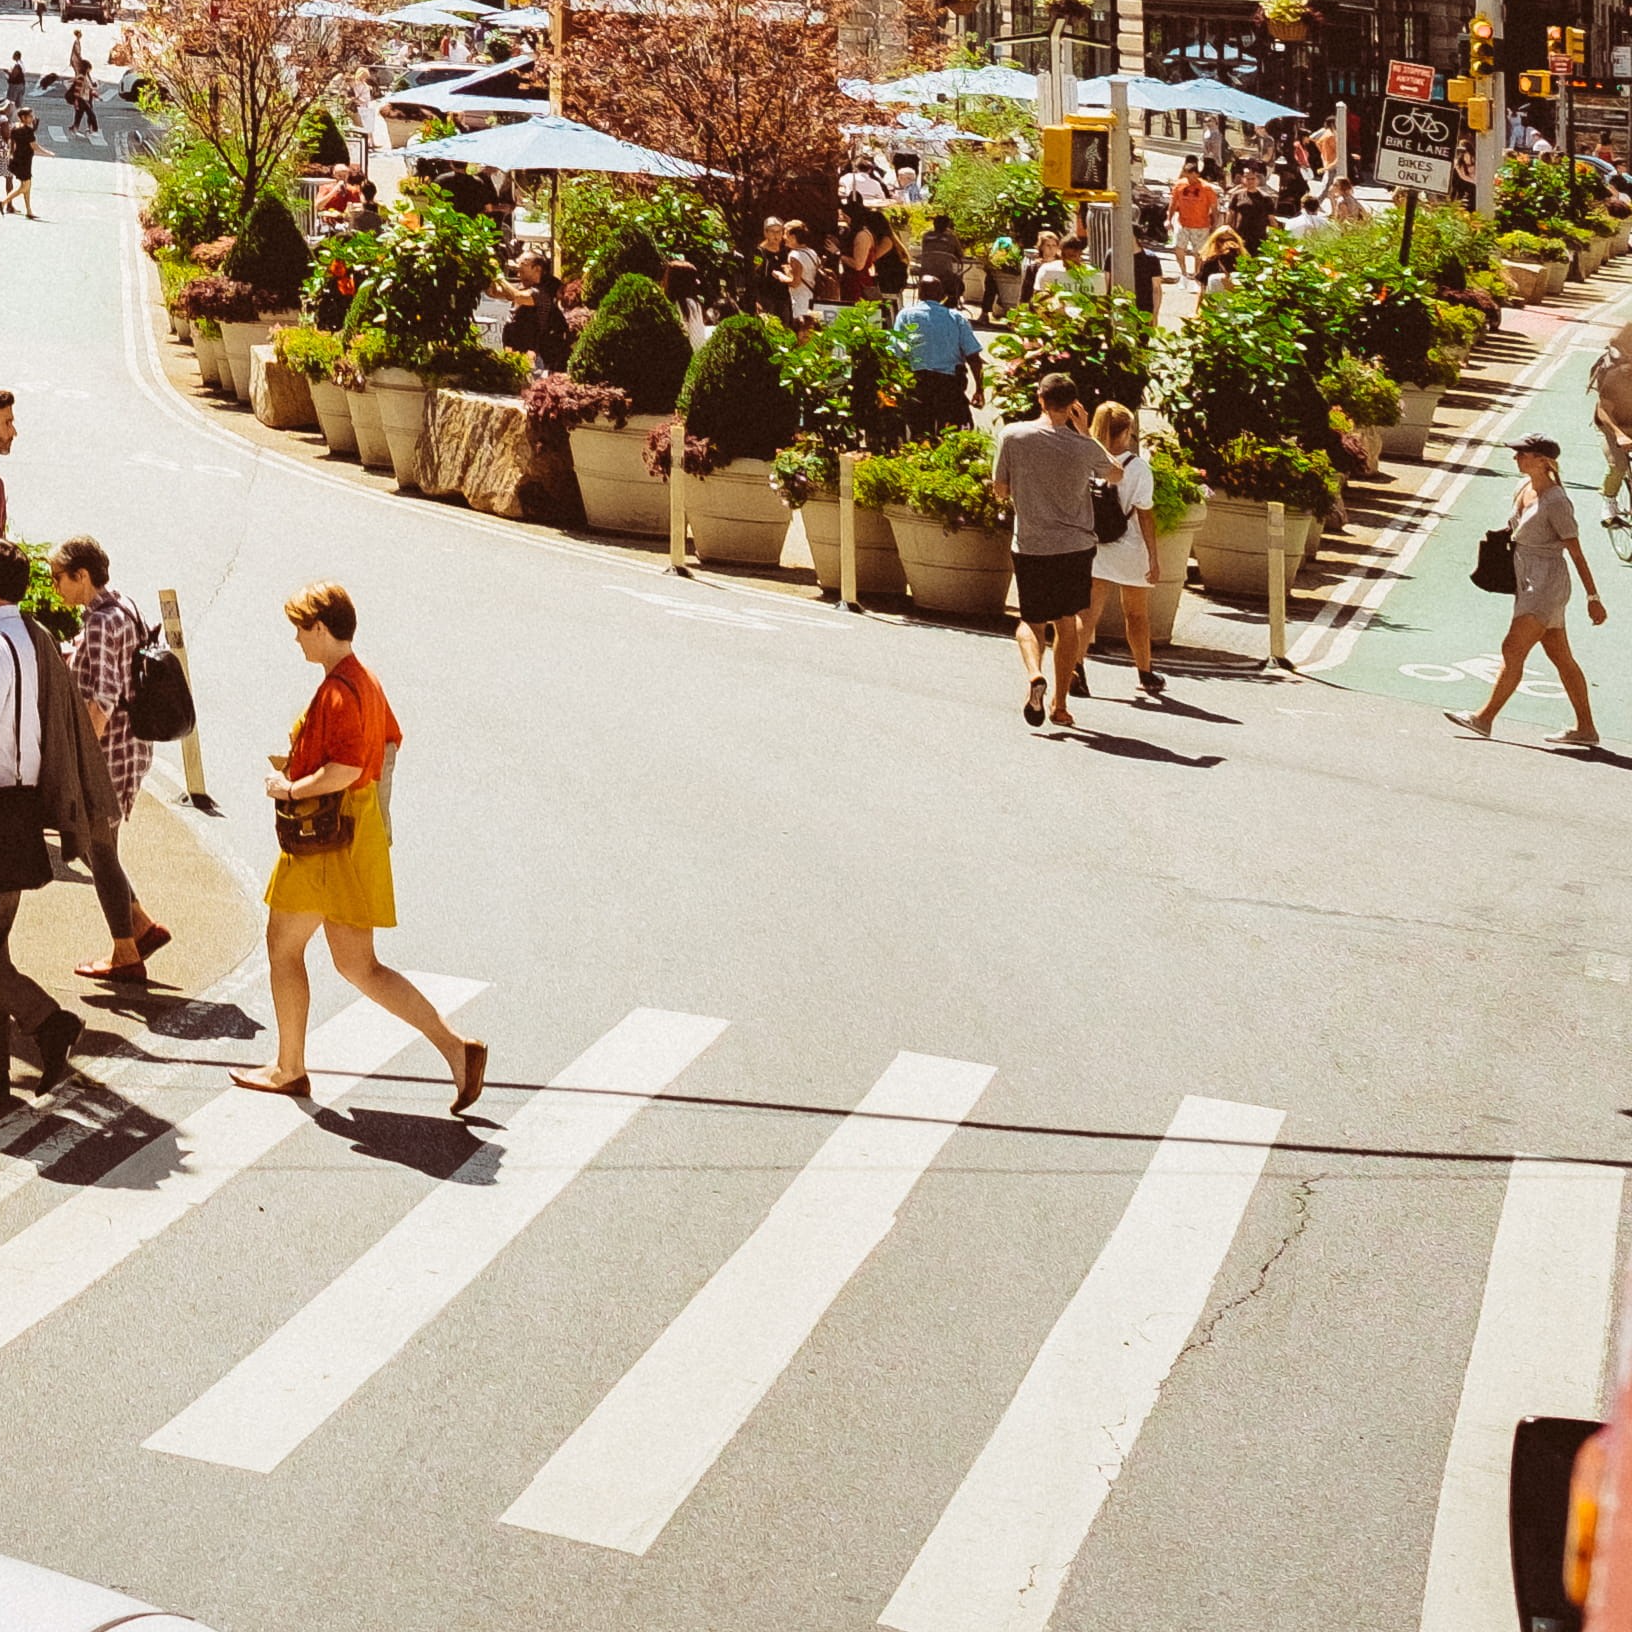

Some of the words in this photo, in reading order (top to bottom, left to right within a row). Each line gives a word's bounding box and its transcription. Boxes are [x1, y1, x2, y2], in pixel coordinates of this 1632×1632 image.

[1385, 136, 1412, 150] BIKE
[1417, 142, 1450, 157] LANE
[1398, 157, 1432, 172] BIKES
[1398, 170, 1429, 183] ONLY
